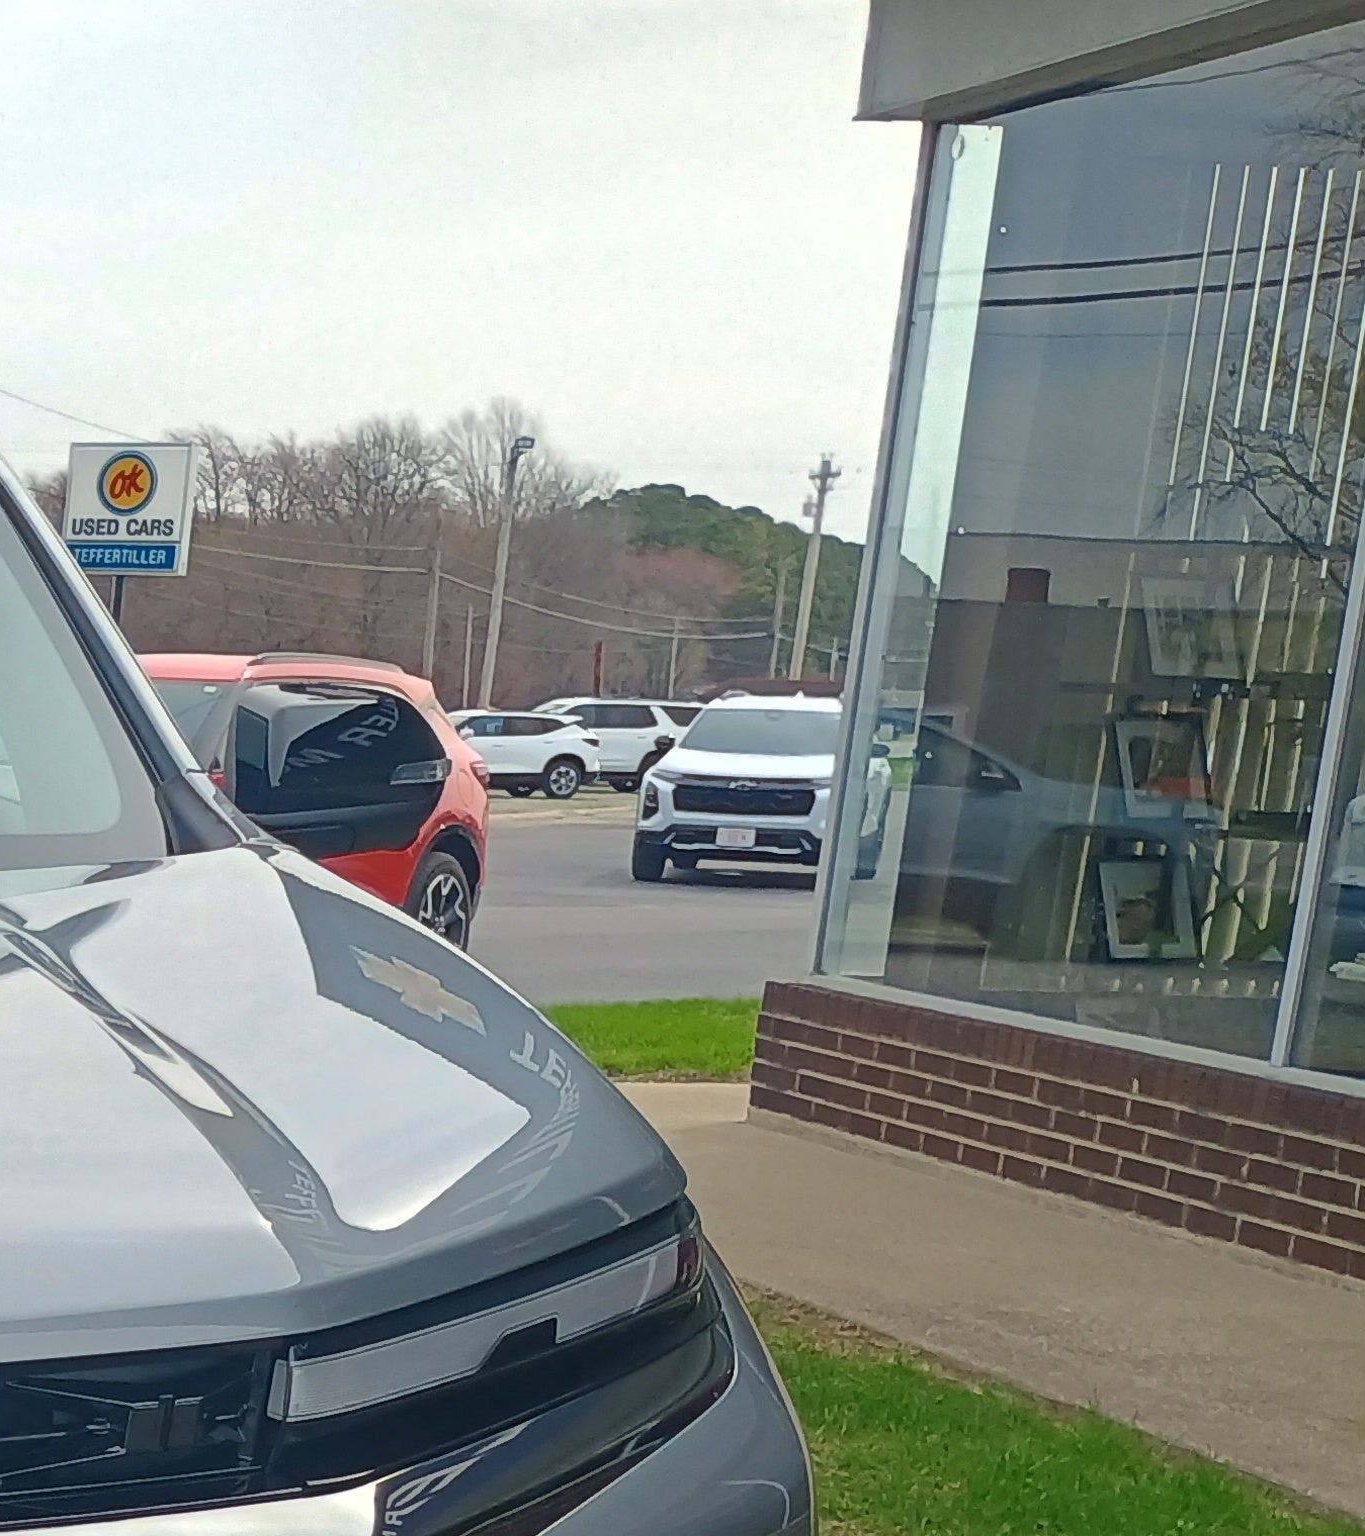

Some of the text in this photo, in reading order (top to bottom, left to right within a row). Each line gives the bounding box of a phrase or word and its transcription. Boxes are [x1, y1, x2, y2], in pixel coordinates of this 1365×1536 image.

[109, 464, 144, 499] OK
[71, 518, 174, 536] USED CARS
